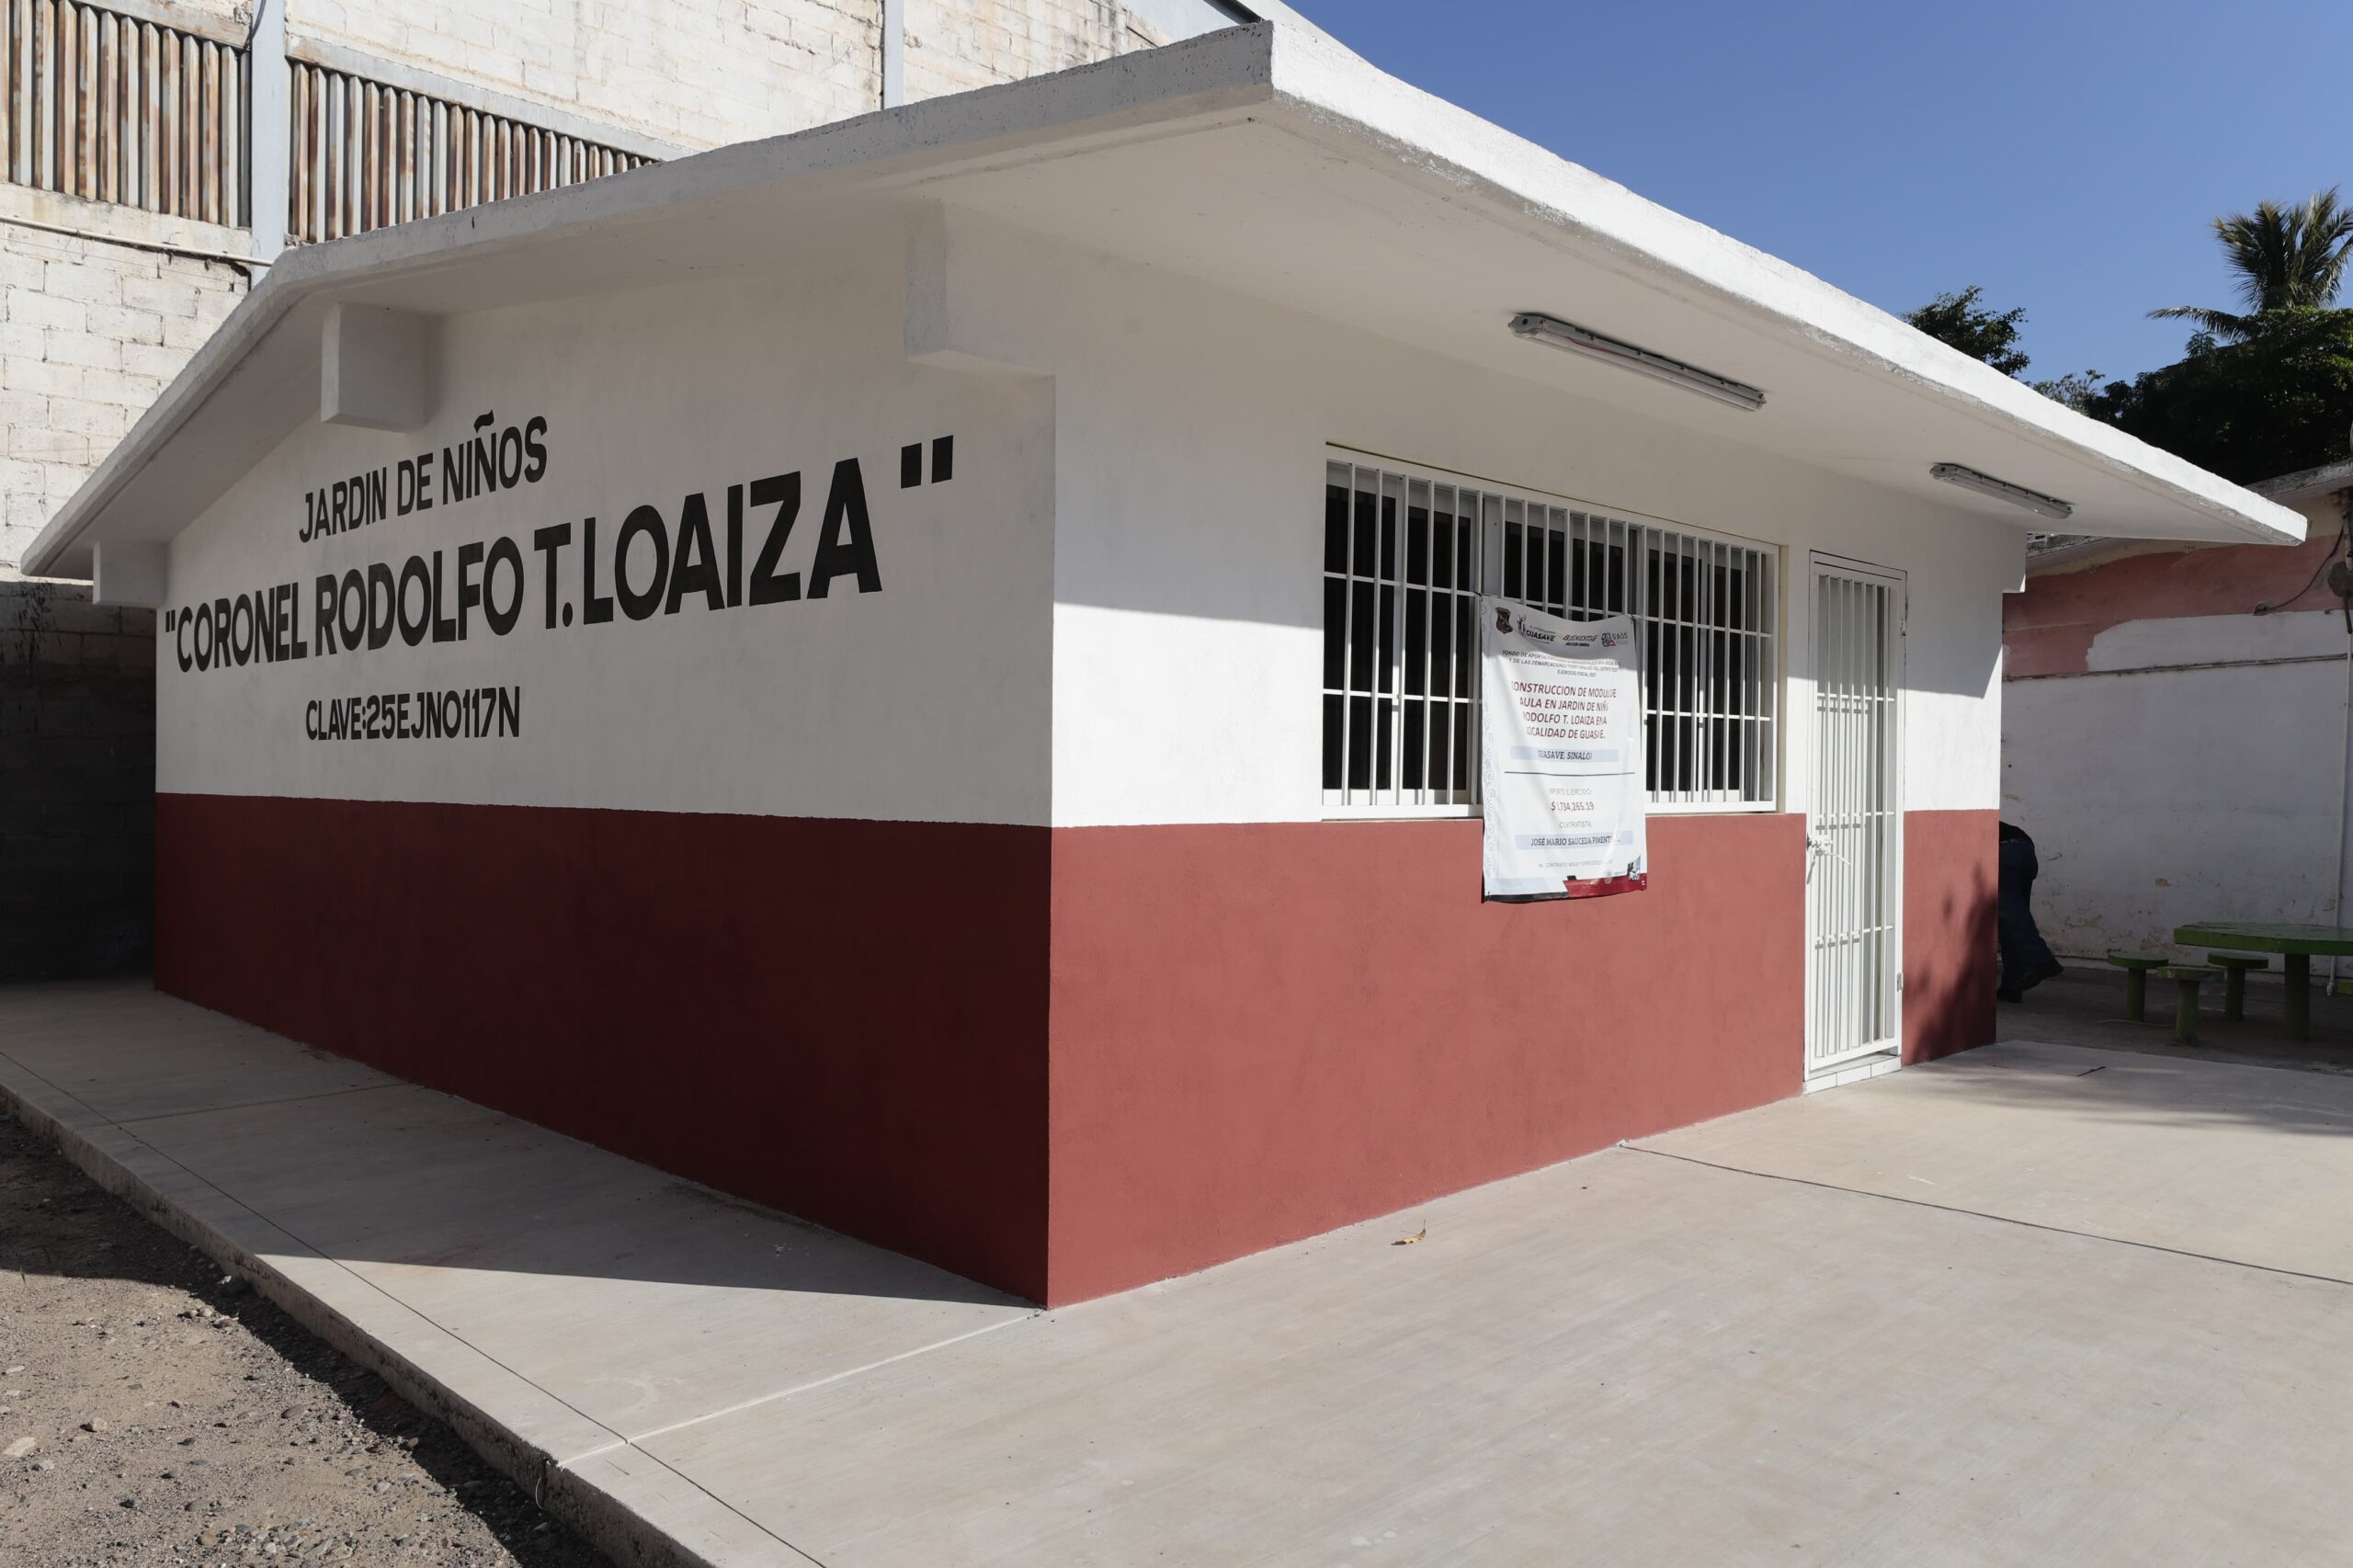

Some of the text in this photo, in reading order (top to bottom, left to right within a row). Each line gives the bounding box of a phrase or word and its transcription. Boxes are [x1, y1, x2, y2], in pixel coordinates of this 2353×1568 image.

[299, 409, 548, 543] JARDIN DE NIÑOS
[165, 582, 308, 673] "CORONEL
[314, 536, 525, 658] RODOLFO
[1526, 630, 1555, 642] GUASAVE
[1577, 687, 1587, 697] DE
[1519, 697, 1542, 708] AULA
[1544, 699, 1557, 710] EN
[1558, 699, 1586, 711] JARDIN
[1586, 701, 1596, 711] DE
[1563, 714, 1569, 724] T.
[1571, 715, 1595, 726] LOAIZA
[1567, 729, 1578, 739] DE
[1530, 835, 1545, 846] JOSÉ
[1546, 837, 1567, 846] MARIO
[1567, 836, 1592, 846] SAUCEDA
